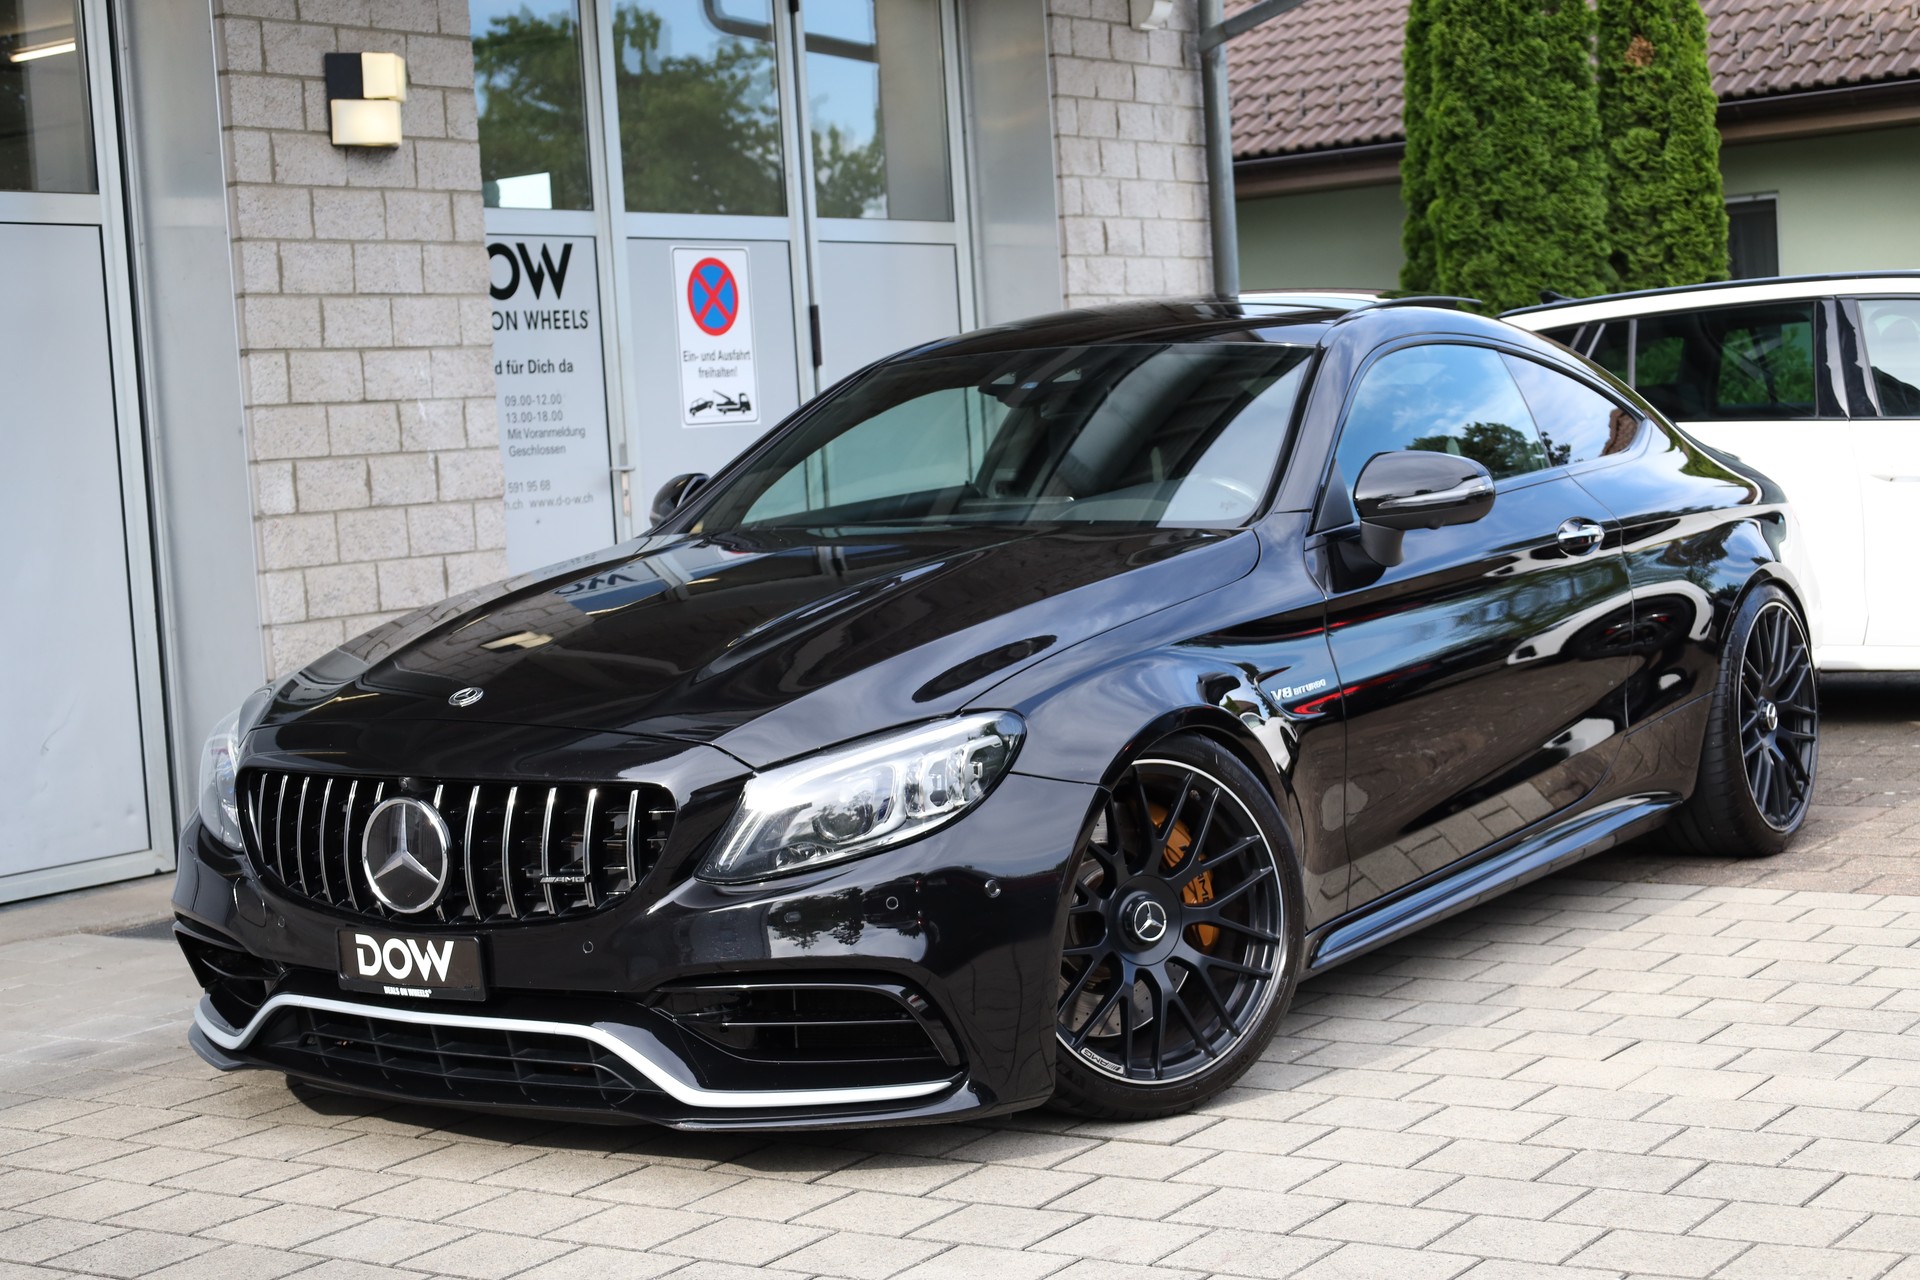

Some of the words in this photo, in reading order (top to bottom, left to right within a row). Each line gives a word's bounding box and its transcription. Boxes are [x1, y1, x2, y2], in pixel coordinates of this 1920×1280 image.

[491, 310, 518, 331] ON
[523, 309, 589, 330] WHEELS
[683, 350, 699, 362] Ein-
[700, 350, 716, 361] und
[717, 349, 751, 361] Ausfahrt
[506, 360, 524, 375] für
[528, 358, 555, 374] Dich
[559, 358, 574, 373] da
[504, 393, 562, 407] 09.00-12.00
[505, 410, 563, 423] 13.00-18.00
[524, 427, 586, 439] Voranmeldung
[508, 444, 567, 457] Geschlossen
[1271, 686, 1293, 701] V8
[1293, 678, 1327, 696] BITURBO
[355, 933, 455, 982] DOW
